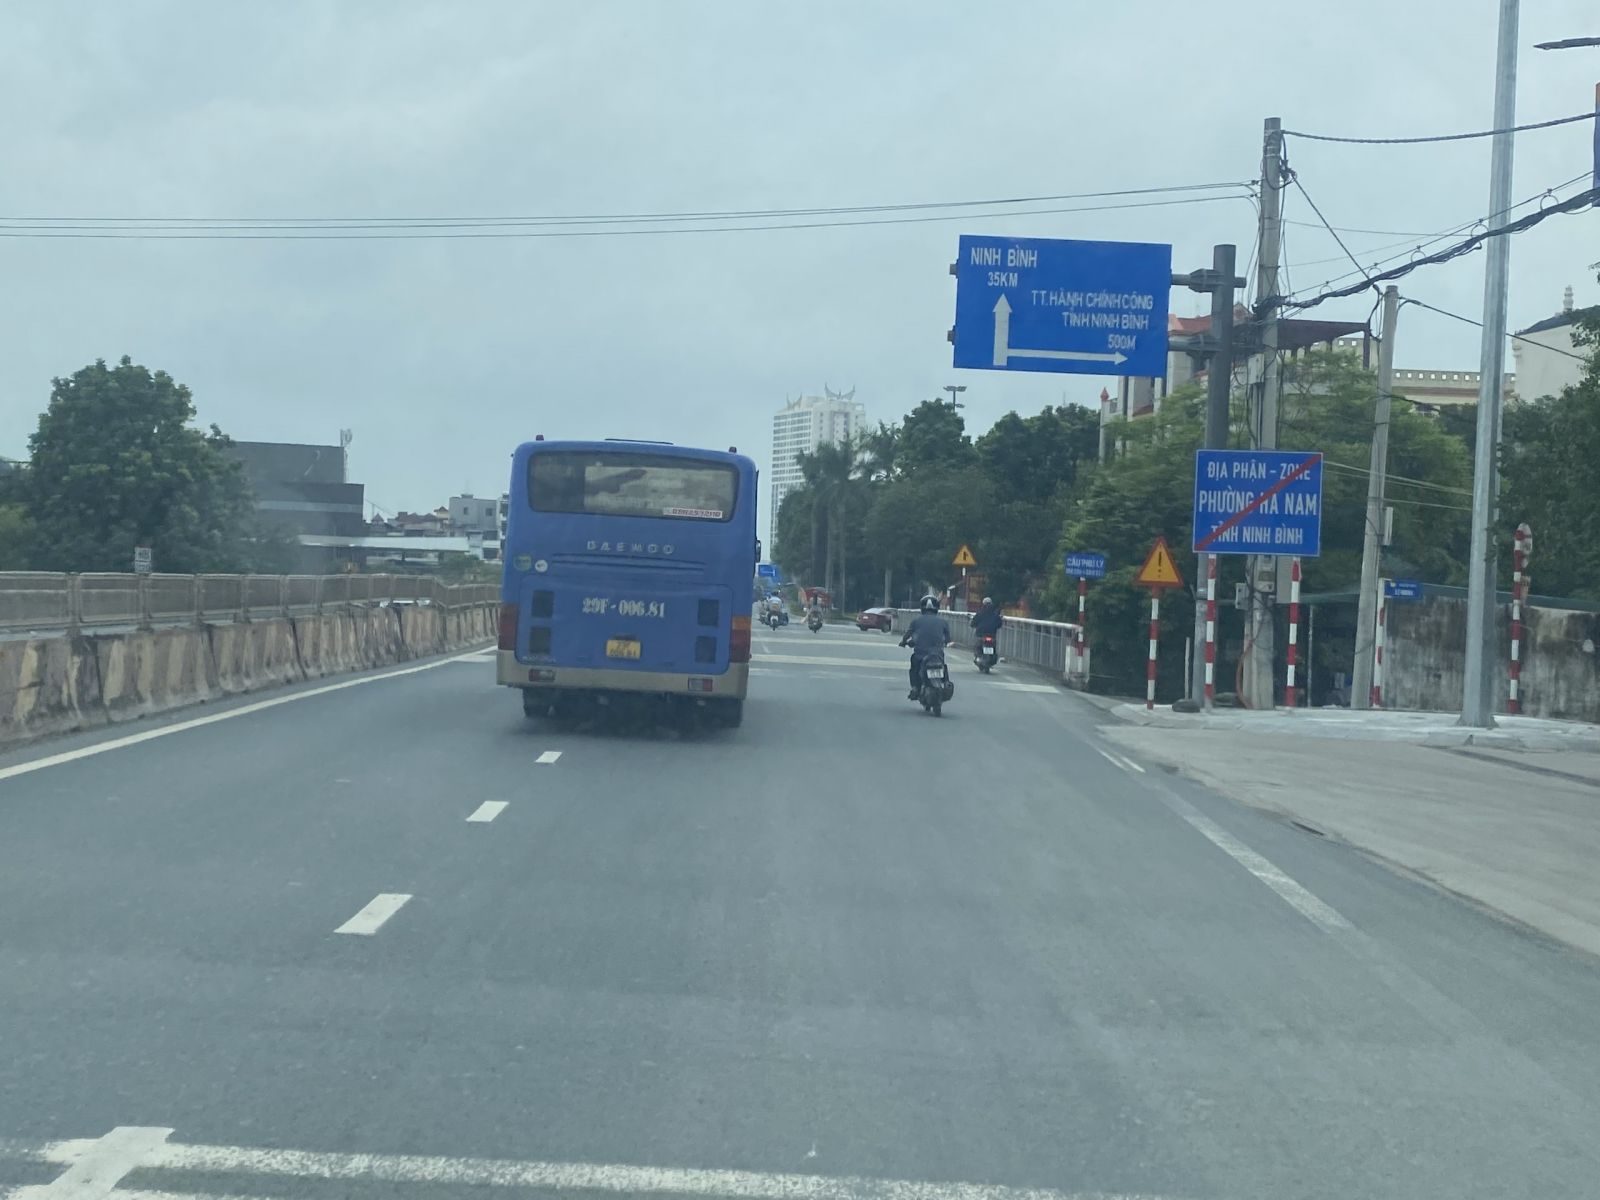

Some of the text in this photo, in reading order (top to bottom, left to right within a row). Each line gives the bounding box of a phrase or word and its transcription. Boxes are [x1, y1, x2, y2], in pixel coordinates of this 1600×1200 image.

[970, 245, 1038, 268] NINH BÌNH
[987, 271, 1018, 288] 35KM
[1085, 289, 1121, 309] CHÍNH
[1121, 293, 1154, 310] CÔNG
[1091, 313, 1120, 329] NINH
[1121, 311, 1149, 330] BÌNH
[1107, 334, 1137, 350] 500M
[1207, 461, 1228, 481] ĐỊA
[1232, 459, 1266, 482] PHẬN
[1279, 463, 1311, 480] ZONE
[1284, 493, 1317, 516] NAM
[1242, 526, 1271, 544] NINH
[1275, 523, 1303, 545] BÌNH
[587, 540, 674, 555] DAEWOO
